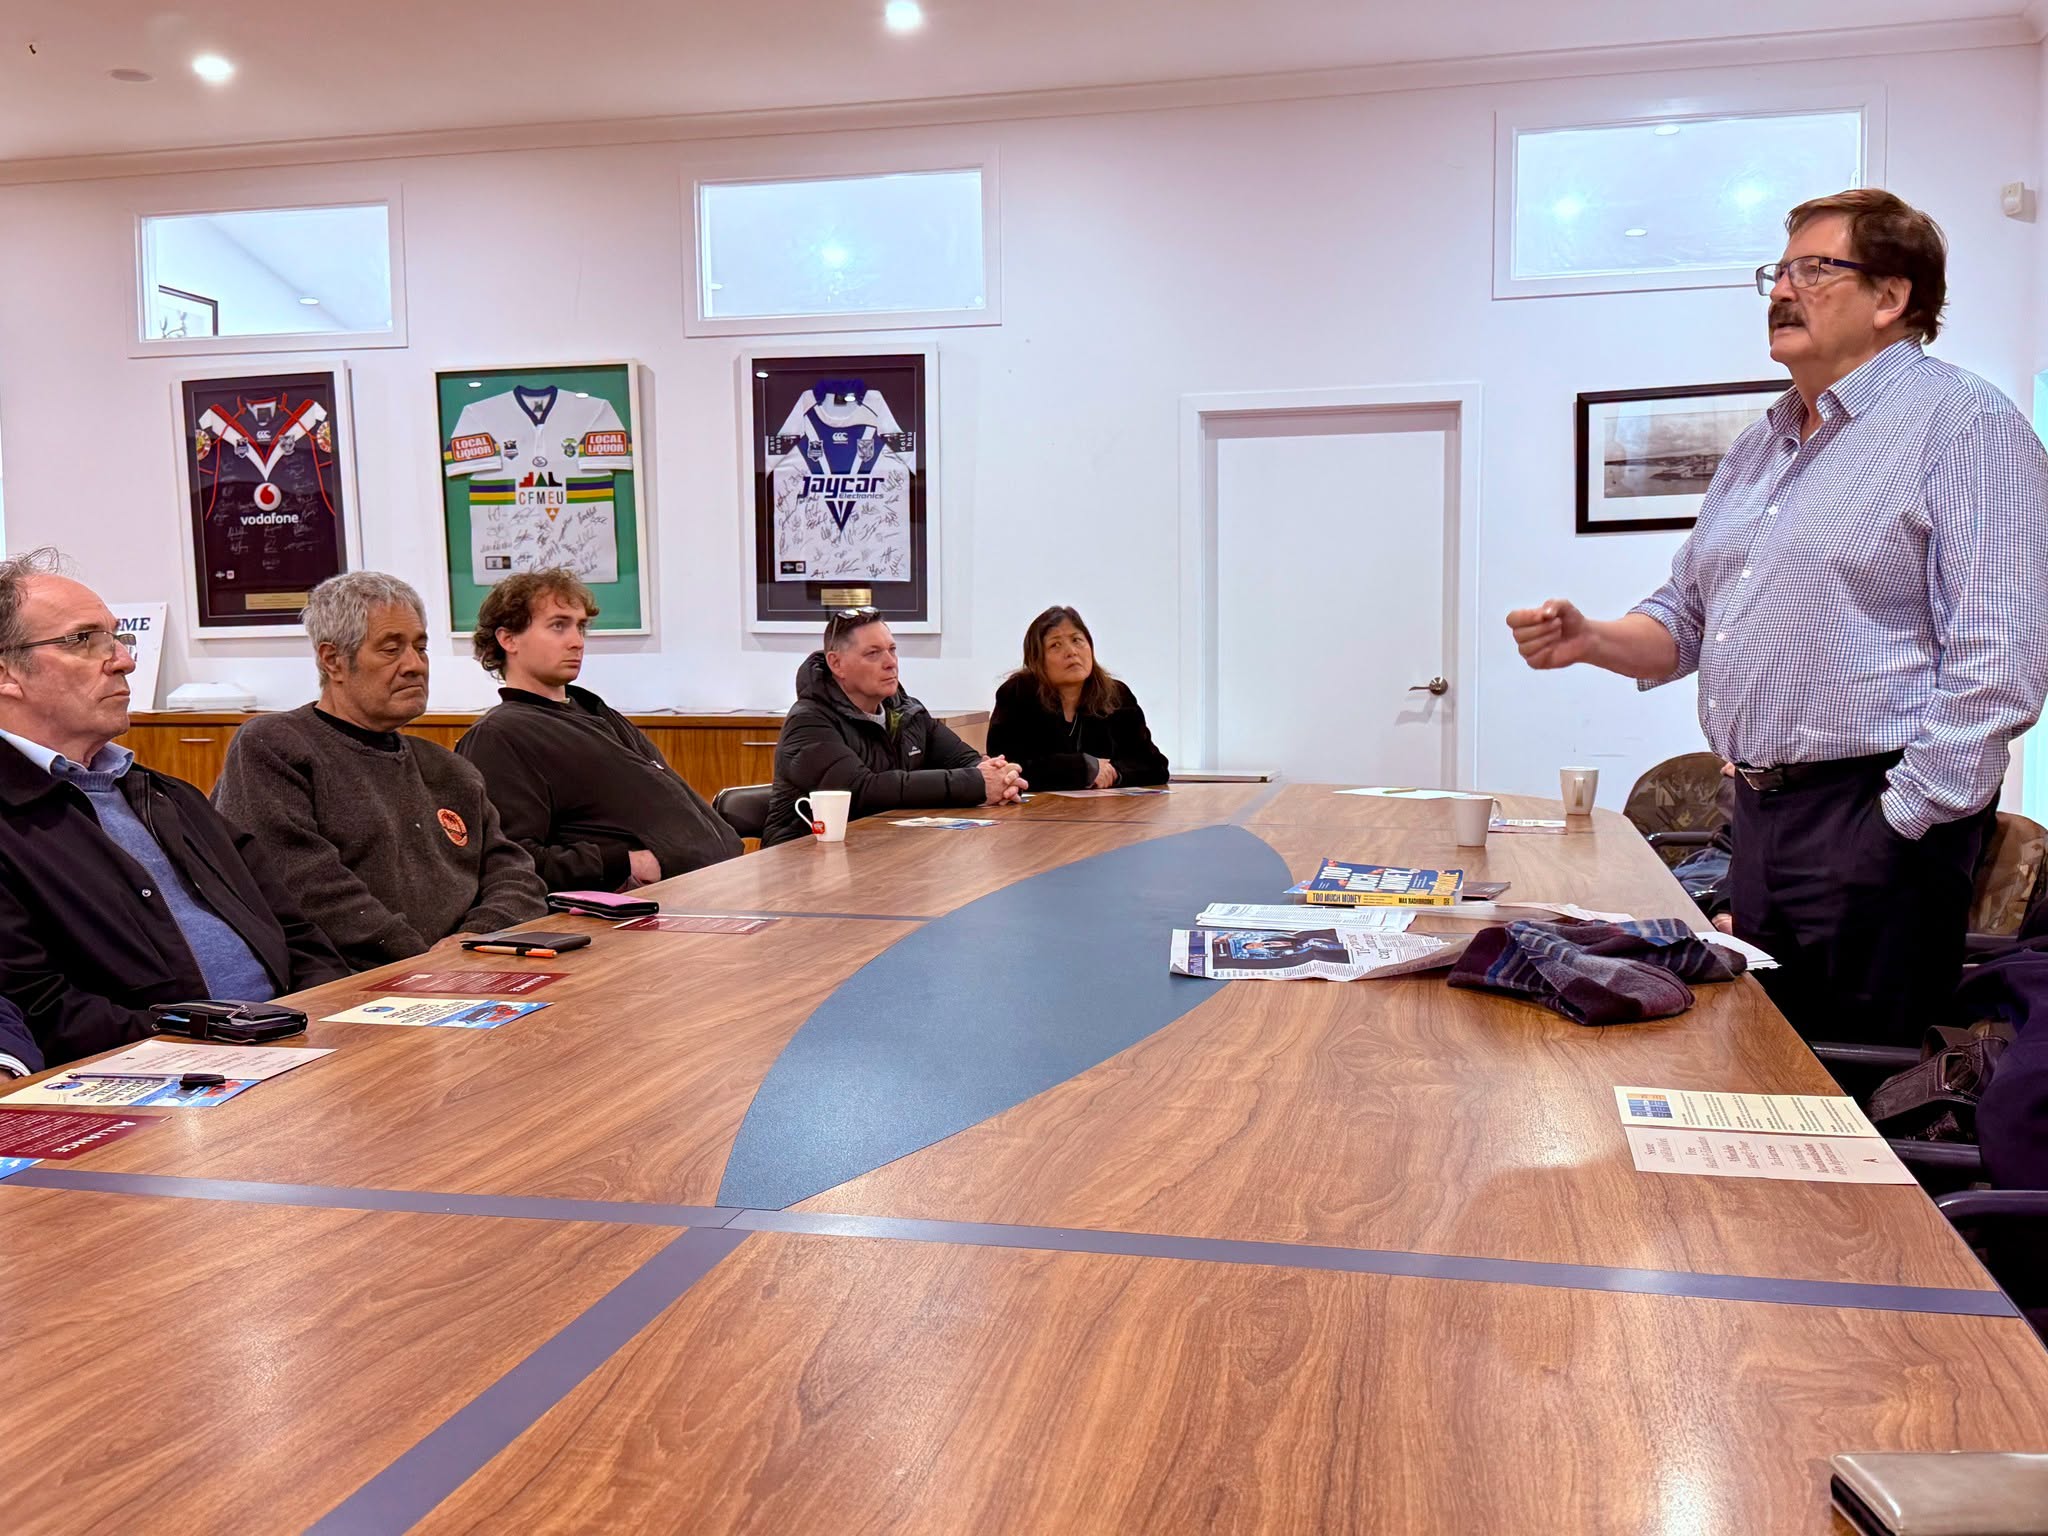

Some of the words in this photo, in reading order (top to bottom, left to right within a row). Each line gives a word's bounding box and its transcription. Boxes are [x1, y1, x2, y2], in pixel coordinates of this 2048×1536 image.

[456, 437, 489, 450] LOCAL
[589, 434, 623, 444] LOCAL
[456, 445, 492, 460] LIQUOR
[588, 443, 624, 455] LIQUOR
[519, 491, 564, 505] CFMEU
[240, 512, 299, 526] vodafone
[1312, 892, 1323, 902] TOO
[1324, 893, 1341, 903] MUCH
[1342, 893, 1362, 903] MONEY
[51, 1120, 137, 1154] ALLIANCE
